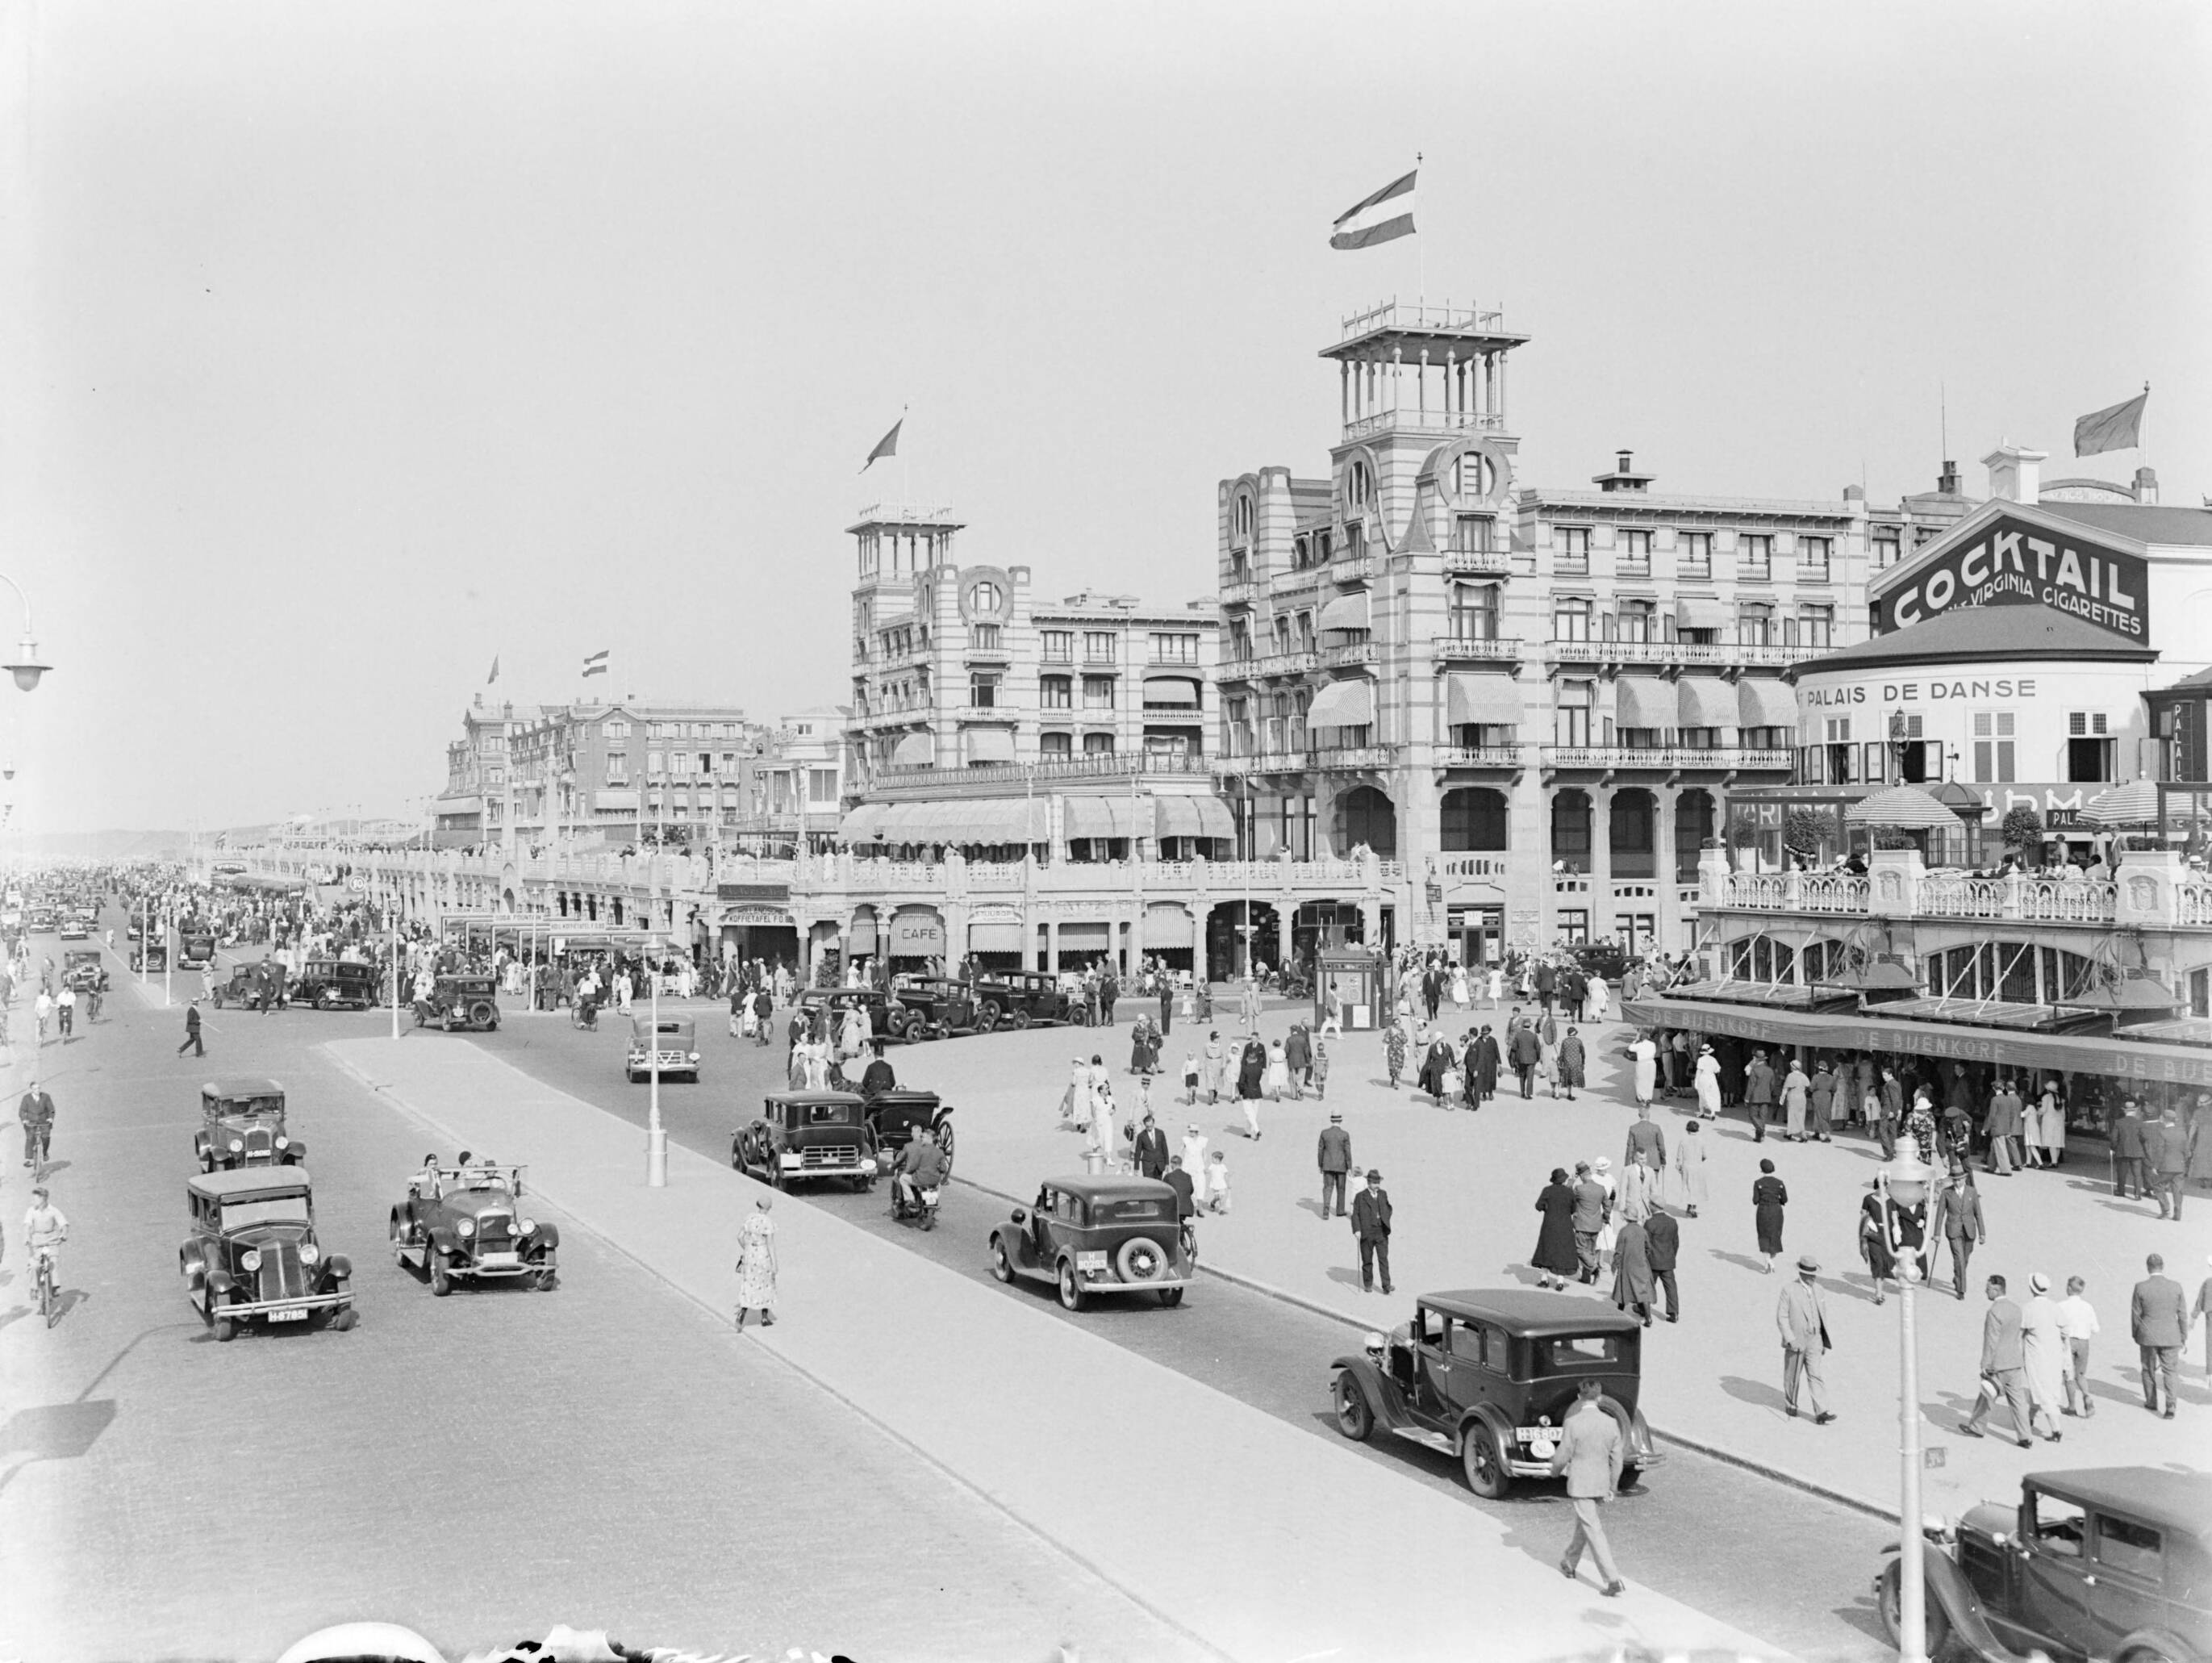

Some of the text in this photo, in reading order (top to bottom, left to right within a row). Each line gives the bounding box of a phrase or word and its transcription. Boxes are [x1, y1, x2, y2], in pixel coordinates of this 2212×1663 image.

[1894, 530, 2135, 629] COCKTAIL
[1971, 573, 2142, 635] VIRGINIA CIGARETTES
[1808, 679, 2036, 707] PALAIS DE DANSE
[2174, 704, 2183, 783] PALAIS
[729, 915, 770, 923] KOFFIETAFEL
[1653, 1009, 1771, 1038] DE BIJENKORF
[1857, 1030, 2005, 1059] DE BIJENKORF
[2116, 1054, 2146, 1076] DE
